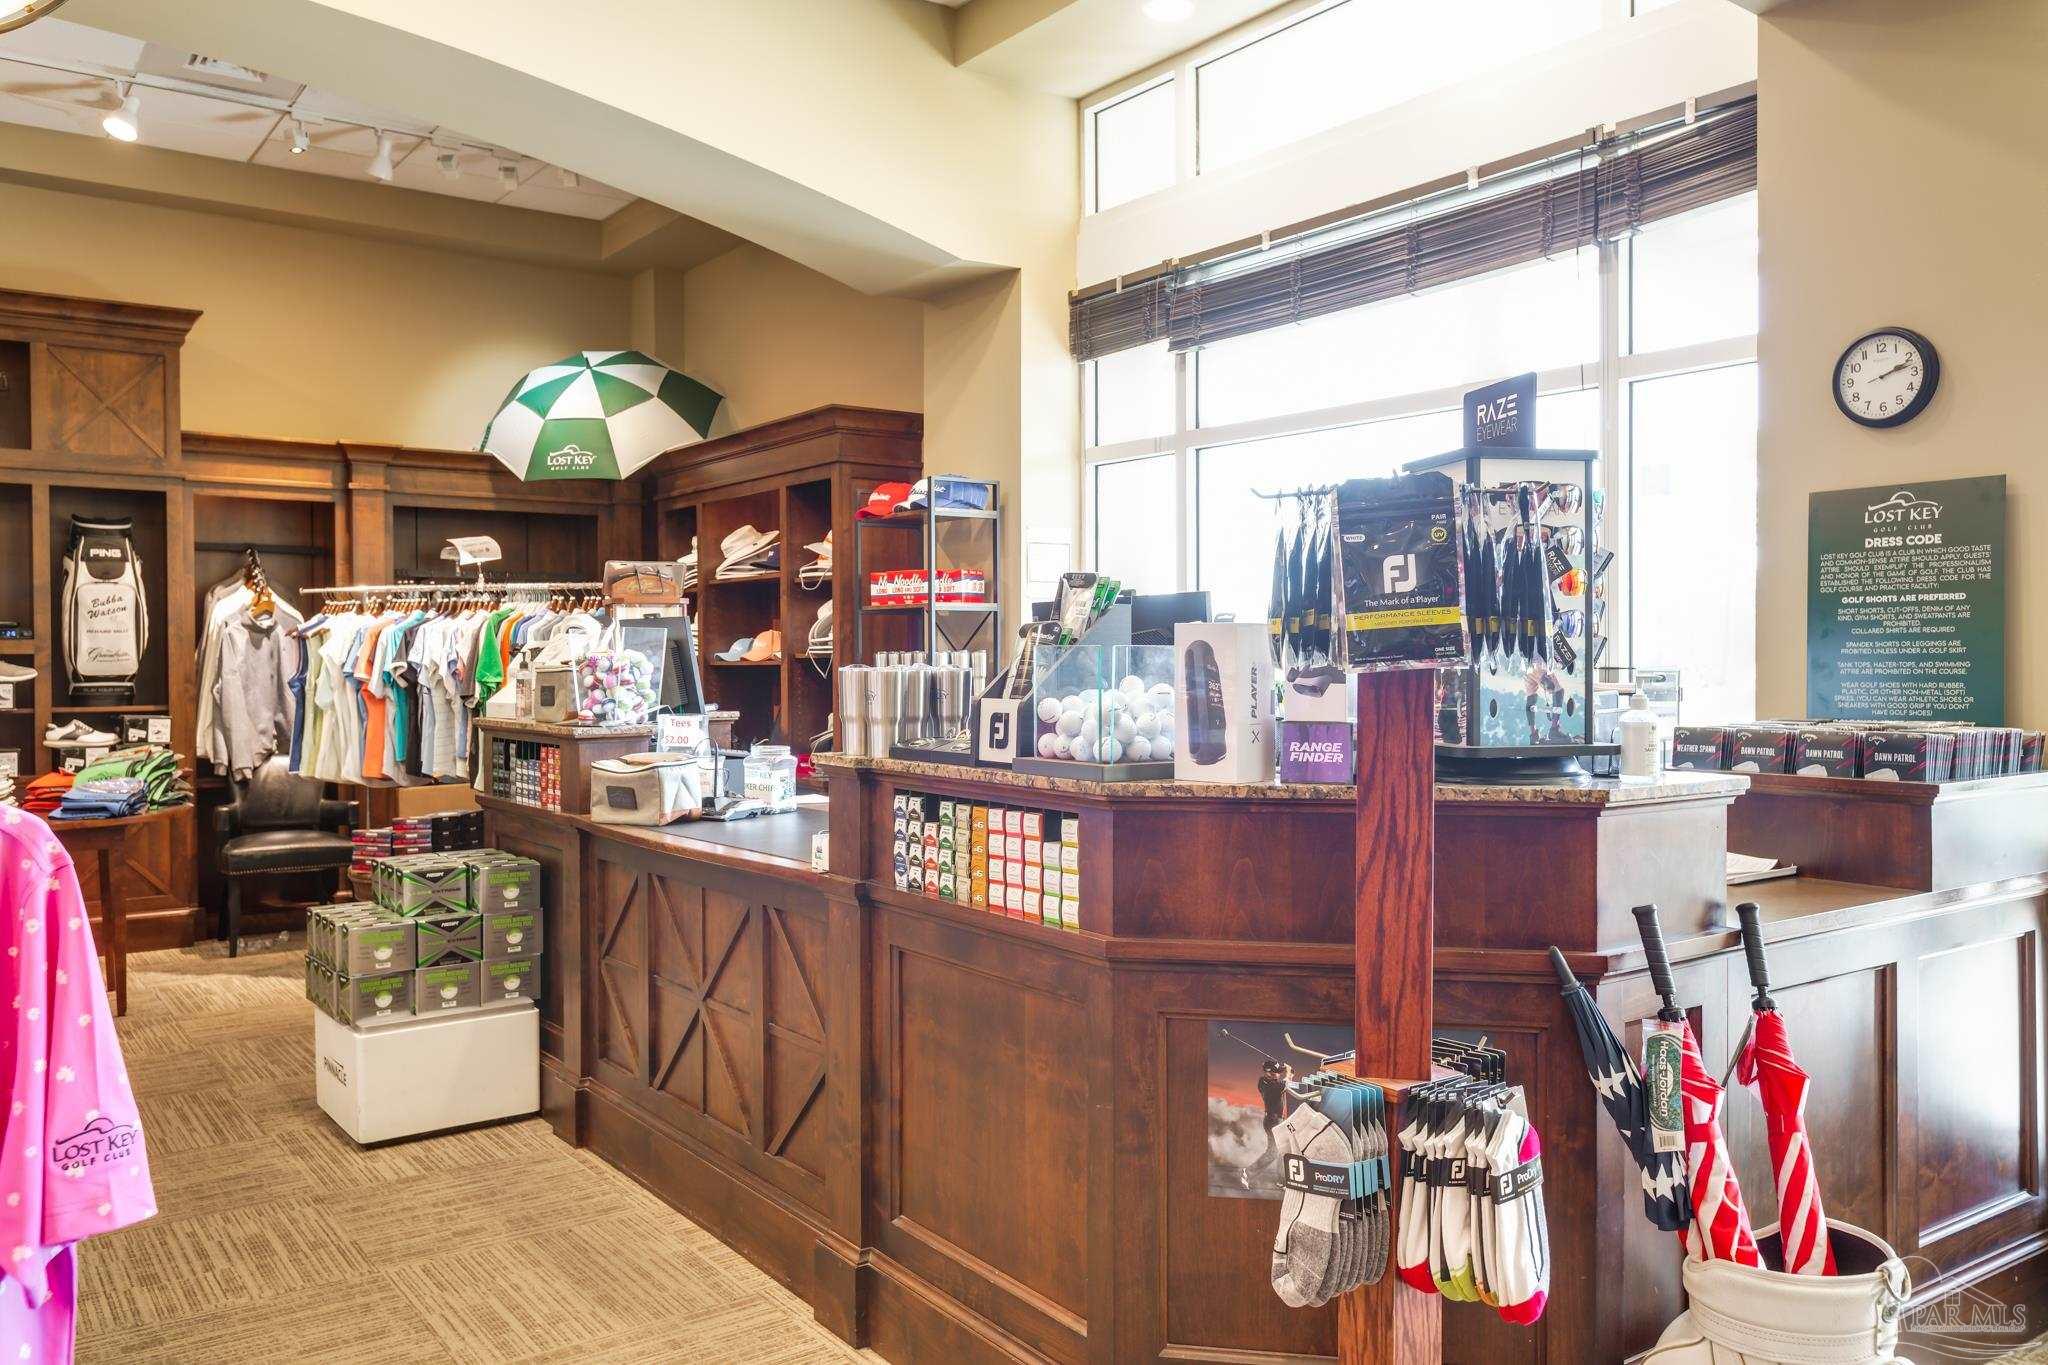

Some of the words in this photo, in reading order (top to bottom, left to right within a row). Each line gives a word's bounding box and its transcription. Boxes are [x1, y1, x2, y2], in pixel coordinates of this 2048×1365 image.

[1876, 343, 1887, 353] 12
[1894, 343, 1898, 354] 1
[1861, 350, 1867, 360] 11
[1905, 351, 1913, 362] 2
[1851, 363, 1861, 373] 10
[1910, 366, 1919, 376] 3
[1846, 378, 1854, 388] 9
[1906, 382, 1914, 392] 4
[1852, 392, 1860, 402] 8
[1896, 395, 1904, 405] 5
[1477, 393, 1518, 426] RAZE
[1865, 400, 1871, 411] 7
[1880, 402, 1887, 412] 6
[1476, 417, 1518, 442] EYEWEAR
[547, 455, 573, 465] LOST
[574, 455, 597, 465] KEY
[1864, 509, 1905, 524] LOST
[1910, 506, 1943, 521] KEY
[1865, 536, 1903, 549] DRESS
[1906, 534, 1943, 546] CODE
[89, 548, 121, 558] PING
[1820, 553, 1835, 561] LOST
[1837, 552, 1849, 560] KEY
[1850, 551, 1866, 559] GOLF
[1868, 550, 1884, 558] CLUB
[1925, 547, 1946, 555] WHICH
[1948, 546, 1970, 554] GOOD
[1971, 545, 1991, 553] TASTE
[1820, 559, 1834, 567] AND
[1835, 557, 1887, 566] COMMON-SENSE
[1889, 556, 1910, 564] ATTIRE
[1912, 555, 1938, 563] SHOULD
[1820, 566, 1840, 574] ATTIRE
[1844, 564, 1869, 572] SHOULD
[1874, 563, 1908, 571] EXEMPLIFY
[1928, 559, 1992, 569] PROFESSIONALISM
[1382, 553, 1417, 594] FJ
[1820, 572, 1834, 580] AND
[1836, 571, 1859, 579] HONOR
[1873, 570, 1885, 578] THE
[1977, 566, 1992, 574] HAS
[894, 574, 923, 586] Noodle
[1820, 578, 1858, 587] ESTABLISHED
[1861, 577, 1873, 585] THE
[1875, 576, 1914, 584] FOLLOWING
[1916, 575, 1937, 583] DRESS
[1939, 574, 1958, 582] CODE
[1961, 573, 1975, 581] FOR
[1979, 572, 1991, 580] THE
[1820, 586, 1837, 594] GOLF
[1837, 585, 1863, 593] COURSE
[91, 595, 123, 608] Bubba
[1364, 599, 1379, 607] The
[1380, 598, 1400, 606] Mark
[1401, 597, 1410, 605] of
[1416, 595, 1439, 605] Player
[1841, 595, 1864, 604] GOLF
[1865, 594, 1897, 604] SHORTS
[1899, 594, 1917, 602] ARE
[1918, 592, 1967, 602] PREFERRED
[87, 605, 127, 619] Watson
[1354, 611, 1415, 621] PERFORMANCE
[1417, 609, 1451, 617] SLEEVES
[1837, 607, 1858, 615] SHORT
[1922, 605, 1944, 613] DENIM
[1956, 604, 1971, 612] ANY
[1250, 665, 1258, 719] PLAYER
[989, 712, 1009, 750] FJ
[1289, 742, 1343, 752] RANGE
[1677, 744, 1698, 752] WEATHER
[1756, 747, 1775, 756] PATROL
[1289, 752, 1344, 763] FINDER
[1806, 749, 1822, 758] DAWN
[1823, 750, 1844, 759] PATROL
[1874, 753, 1893, 762] DAWN
[1894, 753, 1916, 763] PATROL
[1660, 1040, 1669, 1117] Haas-Jordan
[52, 1138, 103, 1163] LOST
[107, 1130, 137, 1148] KEY
[61, 1158, 96, 1171] GOLF
[1451, 1160, 1466, 1179] FJ
[1289, 1159, 1305, 1182] FJ
[1314, 1170, 1345, 1184] ProDRY
[1500, 1173, 1513, 1196] FJ
